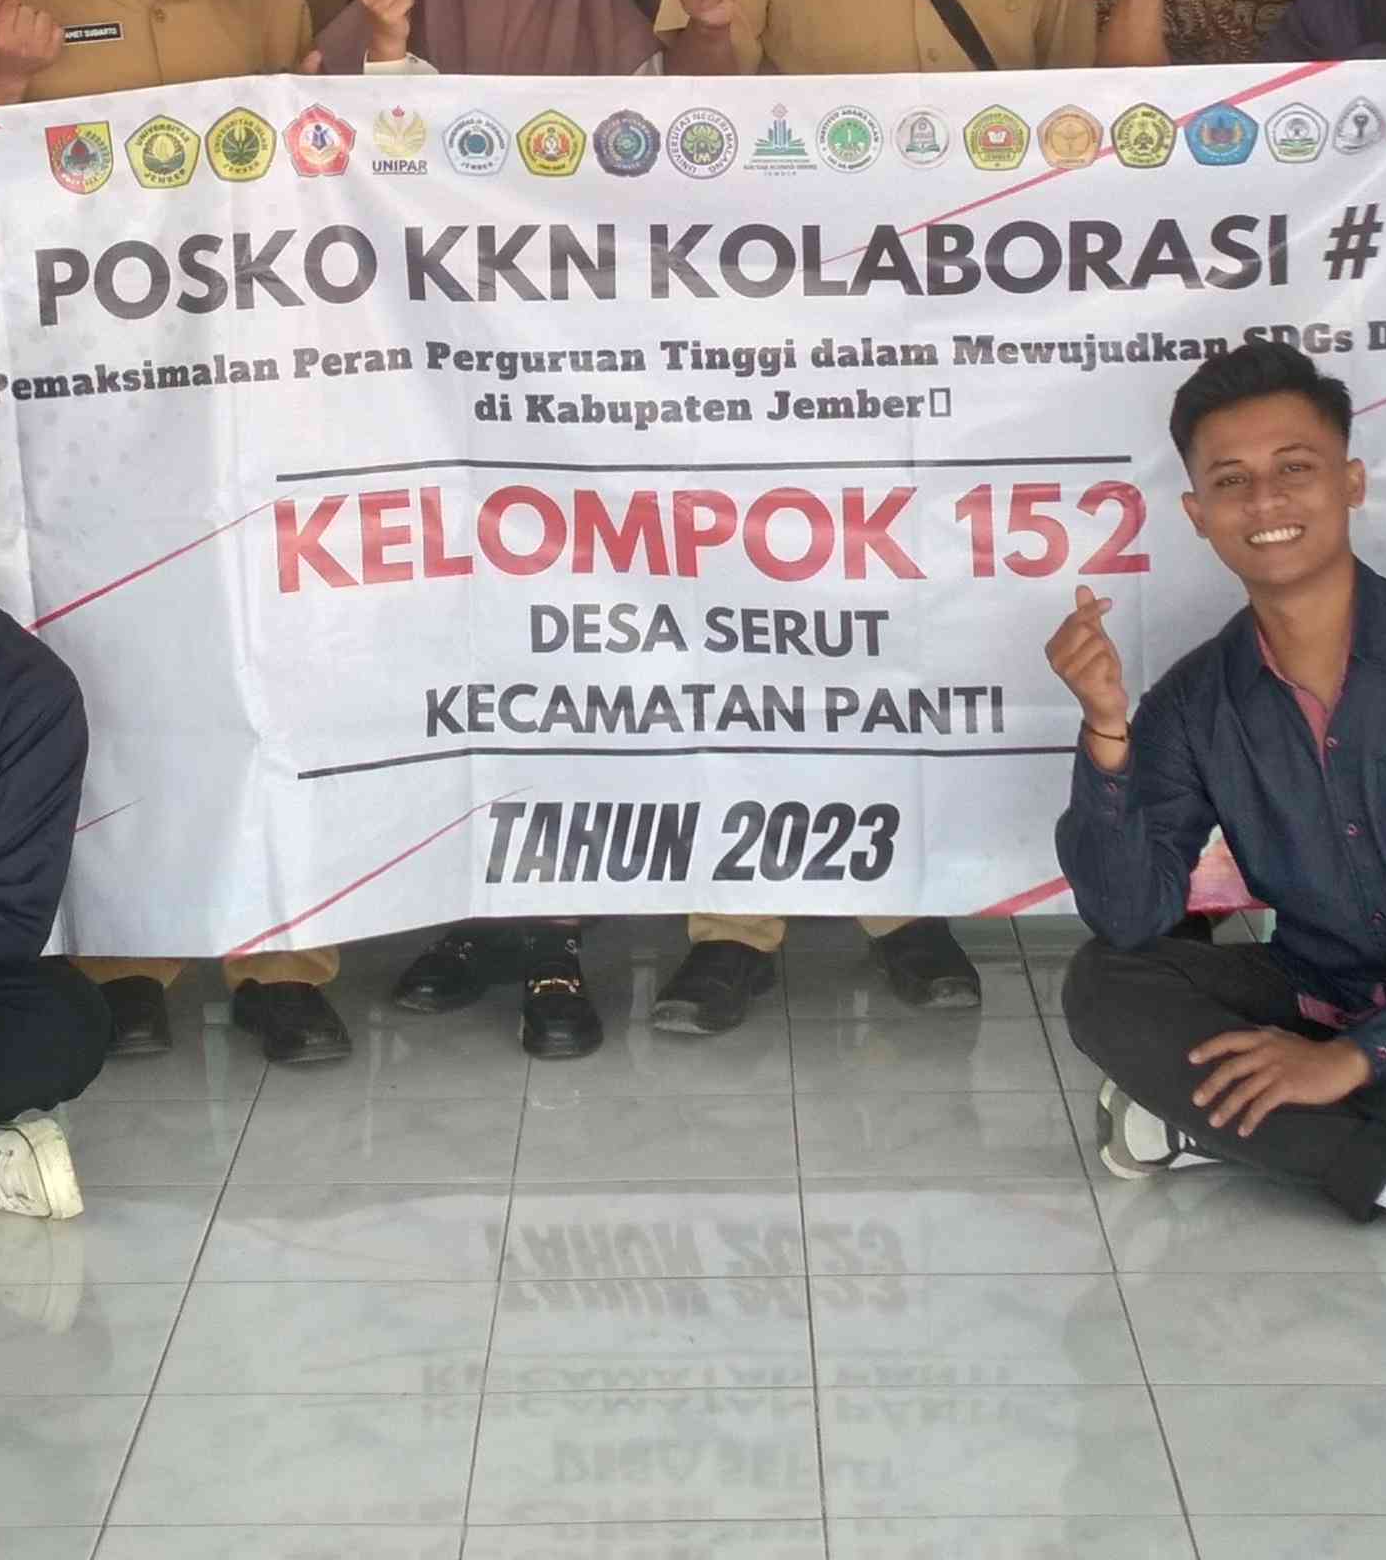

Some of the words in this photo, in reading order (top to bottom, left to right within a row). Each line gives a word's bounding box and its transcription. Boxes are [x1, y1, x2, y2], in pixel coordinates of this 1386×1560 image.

[372, 159, 429, 173] UNIPAR
[35, 225, 379, 327] POSKO
[405, 223, 616, 302] KKN
[649, 213, 1289, 301] KOLABORASI
[293, 344, 412, 378] Peran
[425, 339, 648, 381] Perguruan
[659, 339, 798, 378] Tinggi
[810, 333, 940, 370] dalam
[952, 328, 1230, 372] Mewujudkan
[473, 394, 513, 422] di
[525, 393, 753, 430] Kabupaten
[274, 482, 928, 595] KELOMPOK
[953, 479, 1152, 580] 152
[529, 603, 686, 656] DESA
[703, 608, 889, 658] SERUT
[425, 683, 806, 739] KECAMATAN
[823, 685, 1005, 736] PANTI
[483, 800, 699, 885] TAHUN
[710, 800, 902, 885] 2023
